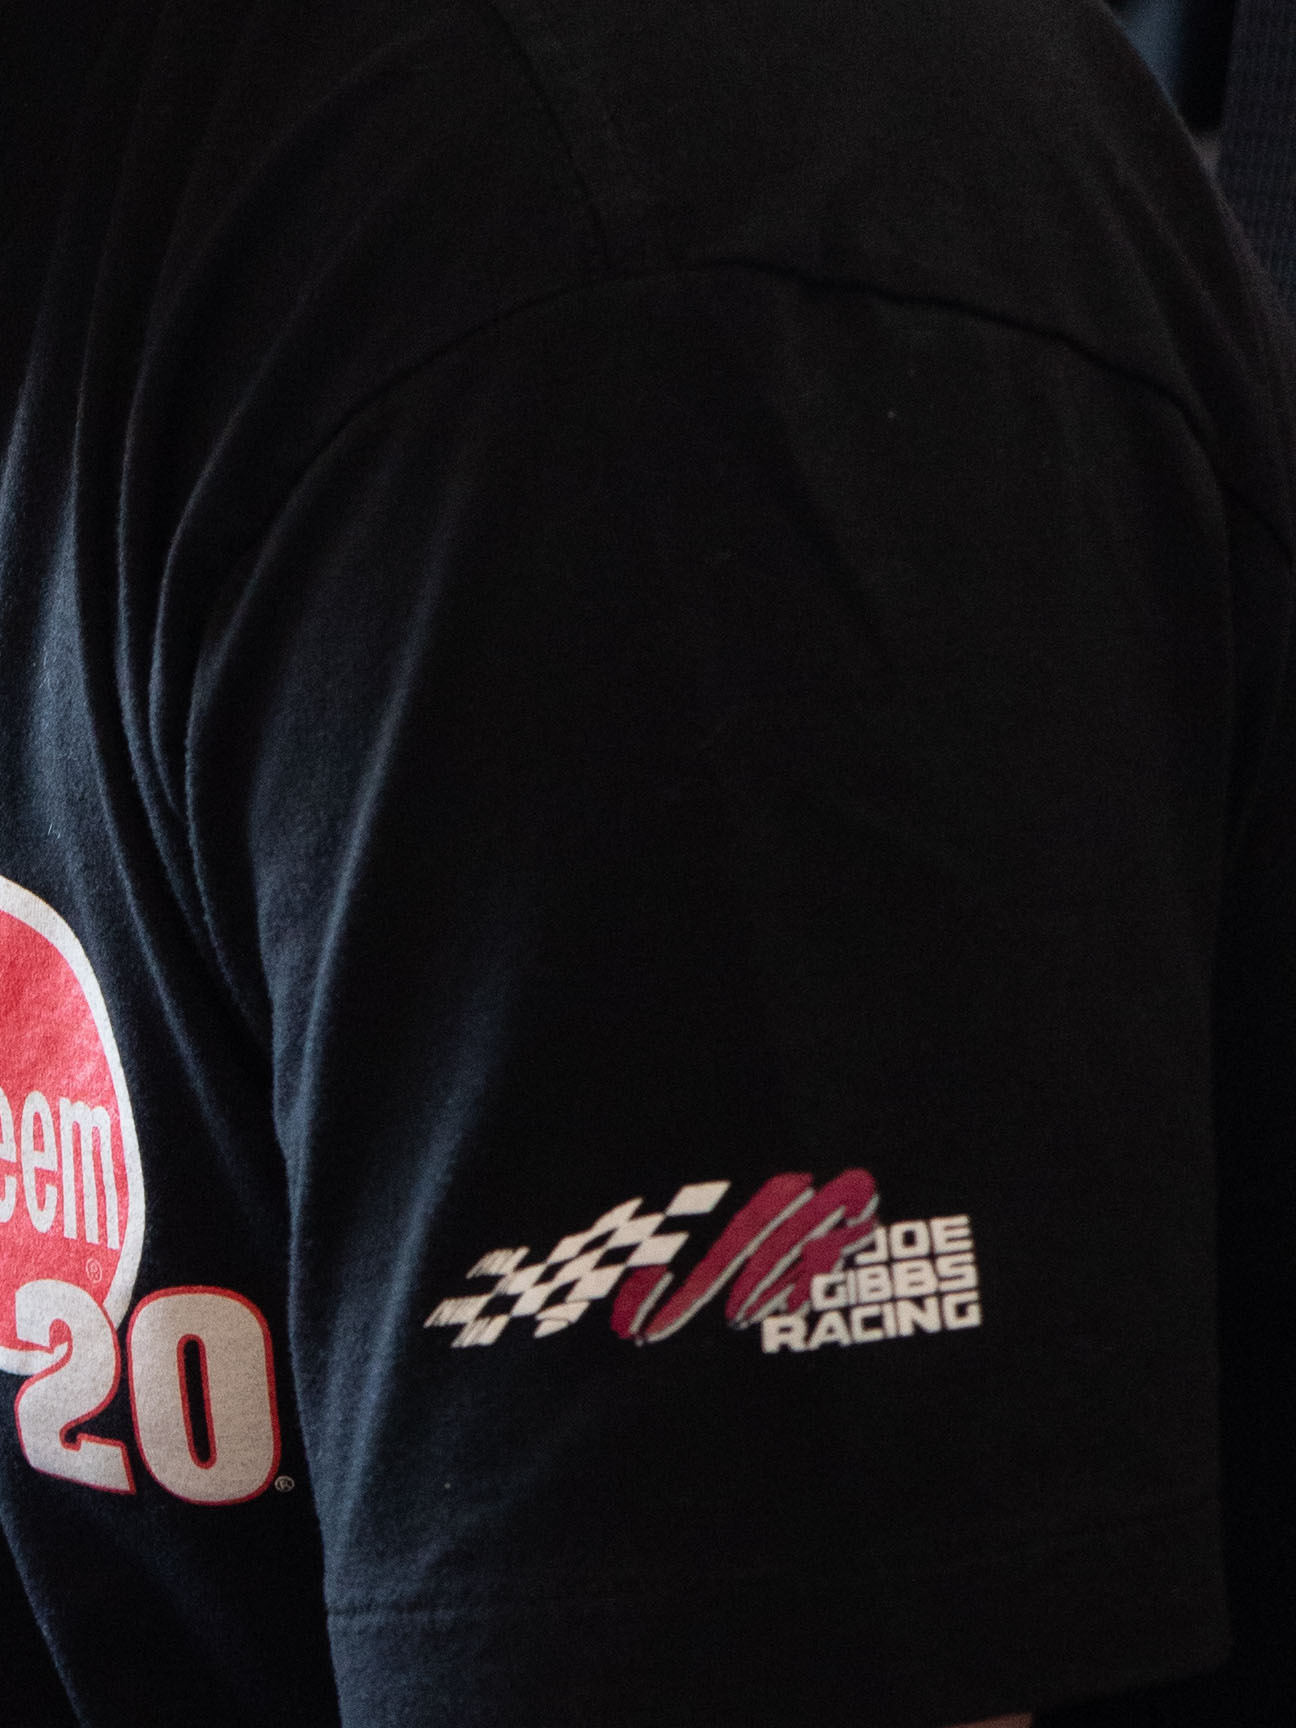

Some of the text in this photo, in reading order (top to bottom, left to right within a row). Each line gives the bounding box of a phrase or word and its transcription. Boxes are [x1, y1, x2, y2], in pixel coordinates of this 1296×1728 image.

[854, 1213, 974, 1265] JOE
[810, 1252, 979, 1312] GIBBS
[760, 1289, 983, 1354] RACING
[14, 1280, 284, 1506] 20
